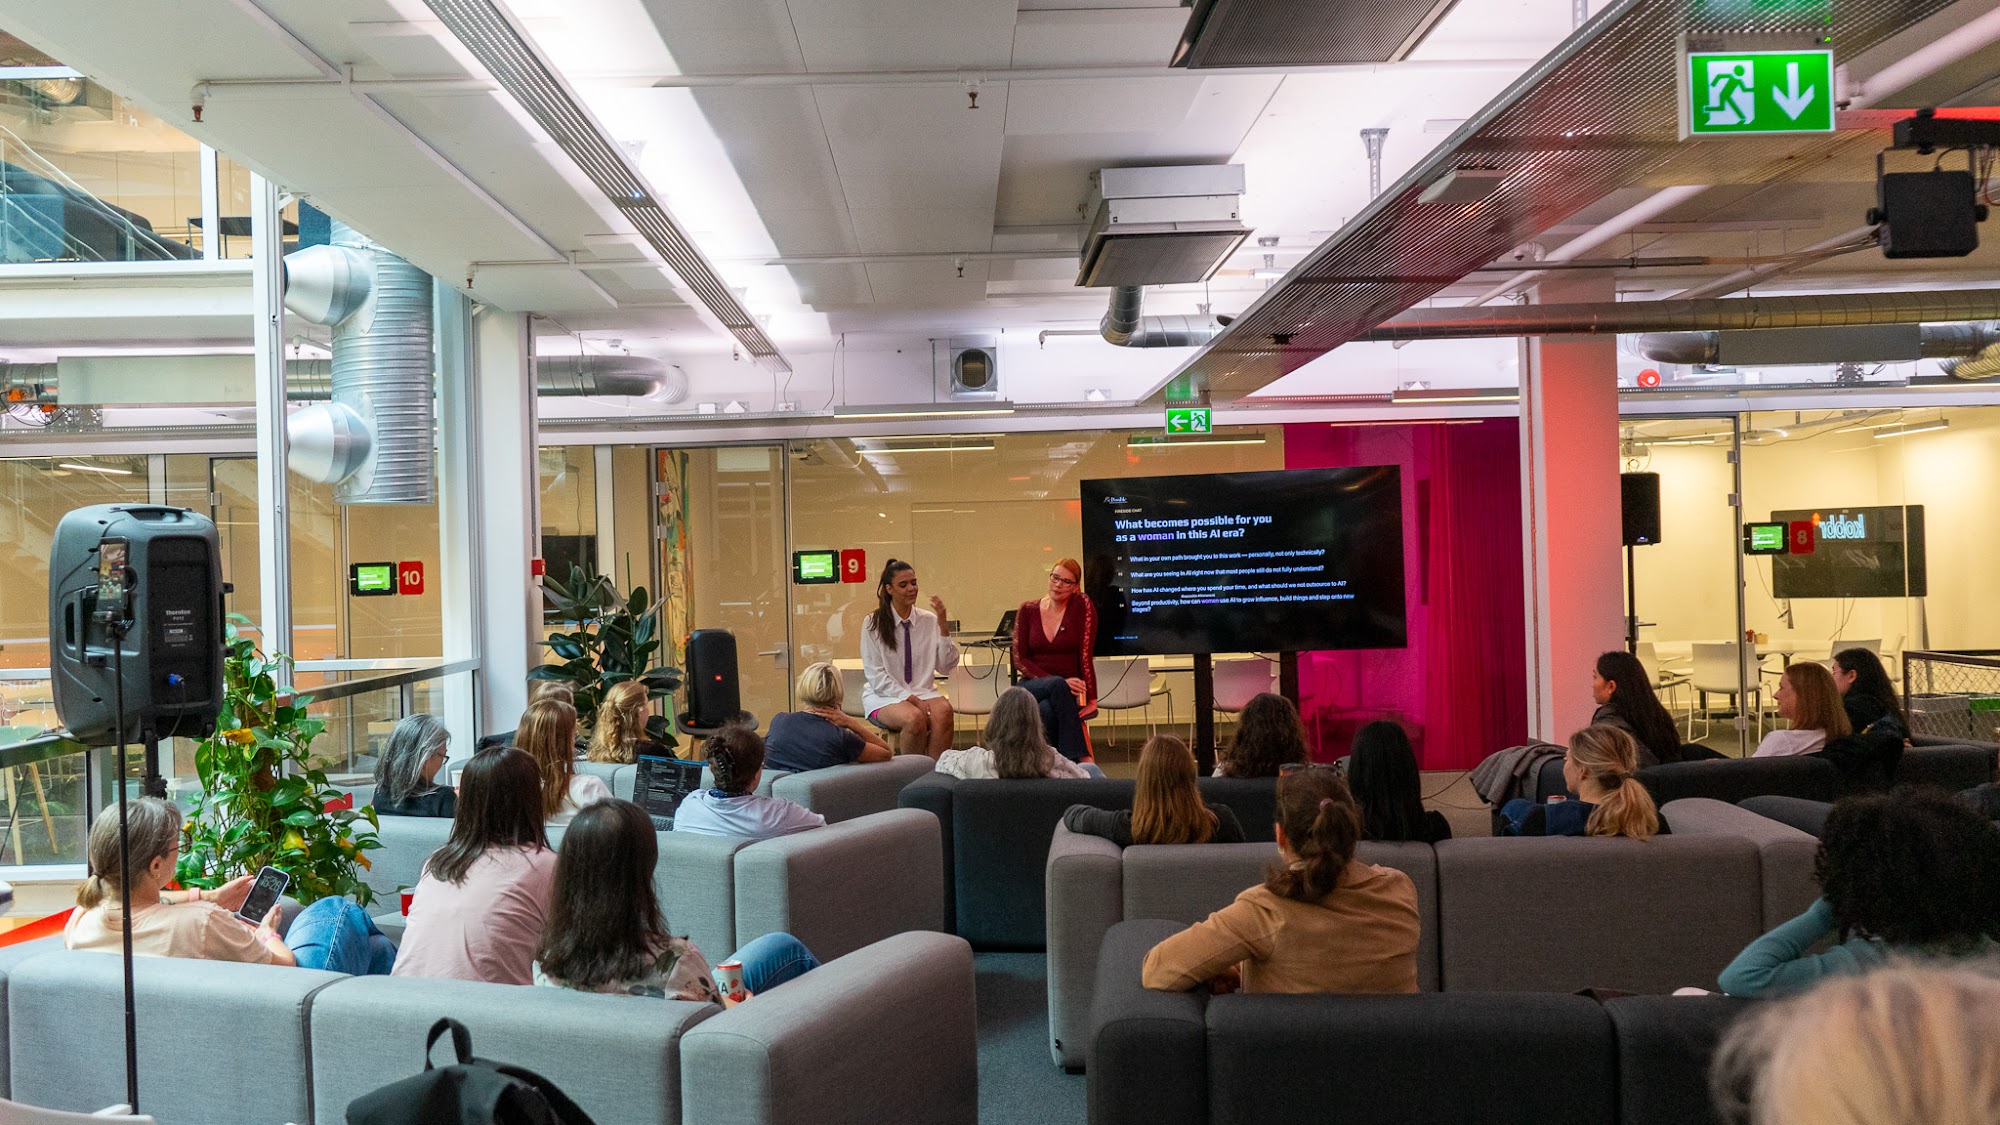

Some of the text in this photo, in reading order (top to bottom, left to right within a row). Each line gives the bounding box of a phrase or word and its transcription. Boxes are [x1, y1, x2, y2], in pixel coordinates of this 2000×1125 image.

[1115, 514, 1272, 529] What becomes possible for you
[1116, 534, 1127, 542] as
[1137, 532, 1174, 541] woman
[1176, 531, 1186, 539] in
[1187, 529, 1208, 539] this
[1209, 529, 1220, 538] AI
[1222, 528, 1245, 537] era?
[1797, 530, 1807, 544] 8
[848, 558, 859, 573] 9
[402, 570, 420, 585] 10
